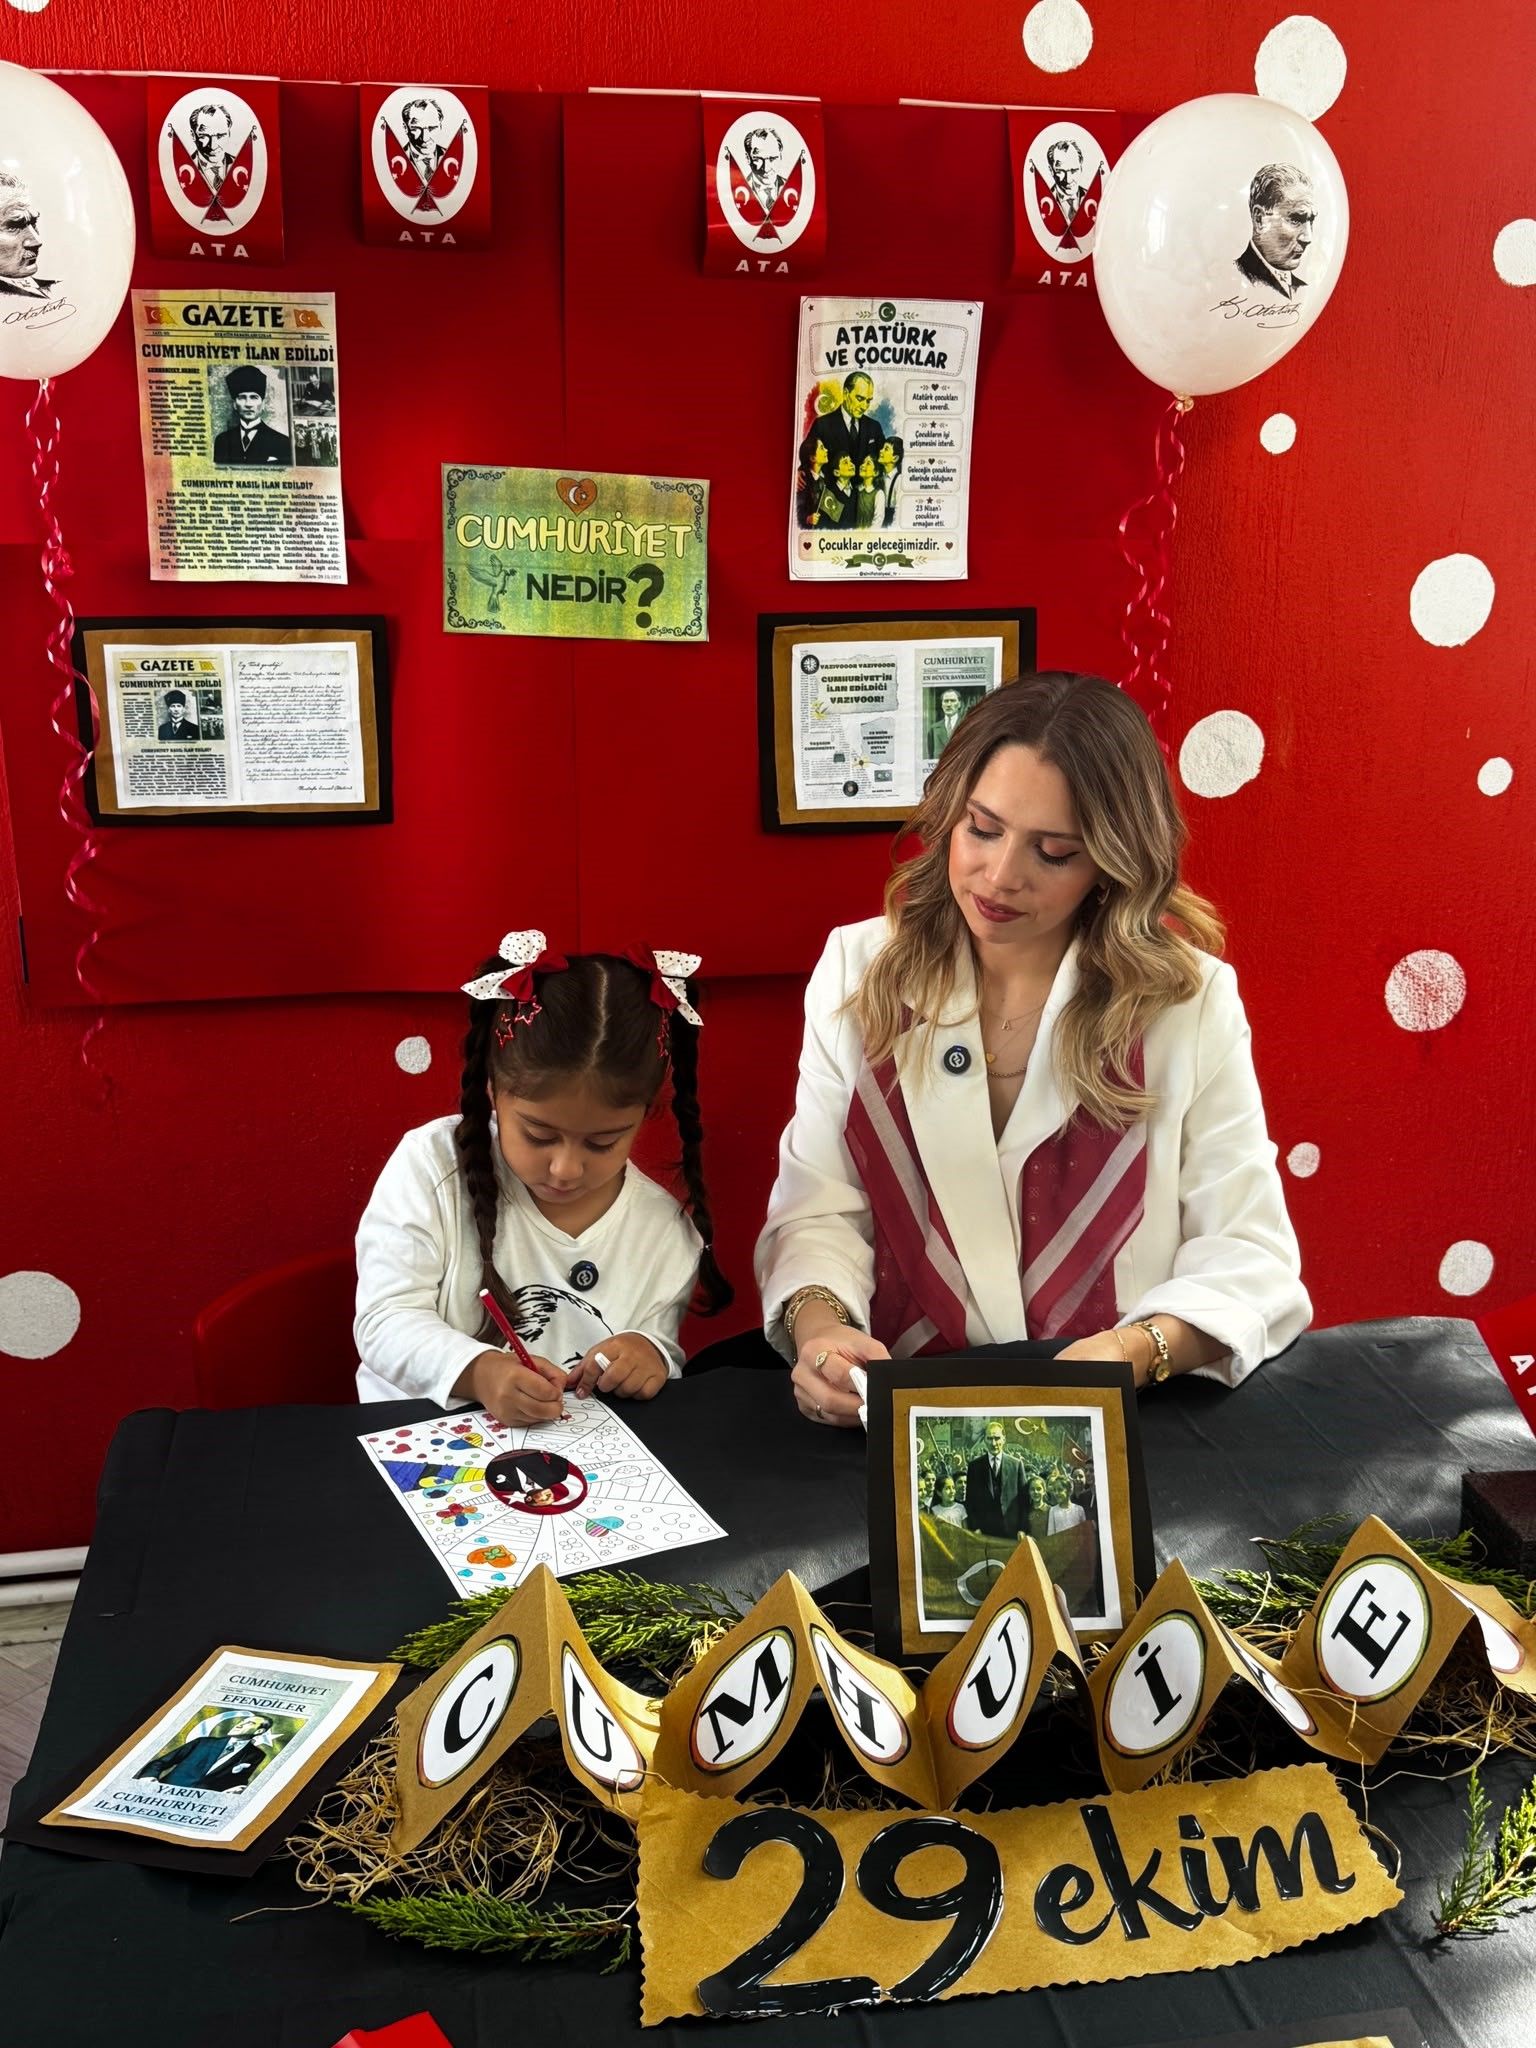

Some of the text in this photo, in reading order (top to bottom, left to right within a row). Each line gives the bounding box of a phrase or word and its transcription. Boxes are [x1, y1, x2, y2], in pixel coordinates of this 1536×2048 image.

[400, 230, 456, 245] ATA
[189, 242, 249, 258] ATA
[735, 259, 790, 274] ATA
[1038, 270, 1088, 287] ATA
[182, 304, 285, 327] GAZETE
[836, 322, 937, 348] ATATÜRK
[142, 342, 334, 362] CUMHURİYET İLAN EDİLDİ
[825, 347, 948, 370] VE ÇOCUKLAR
[912, 393, 933, 401] Atatürk
[919, 402, 929, 412] çok
[181, 479, 313, 490] CUMHURİYET NASIL İLAN EDİLDİ?
[455, 511, 692, 559] CUMHURİYET
[818, 538, 940, 553] Çocuklar geleceğimizdir.
[526, 562, 665, 629] NEDİR?
[141, 660, 195, 671] GAZETE
[924, 656, 985, 665] CUMHURİYET
[119, 678, 222, 689] CUMHURİYET İLAN EDİLDİ
[229, 1675, 331, 1696] CUMHURİYET
[221, 1694, 307, 1713] EFENDİLER
[157, 1785, 207, 1799] YARIN
[112, 1791, 228, 1816] CUMHURİYETİ
[94, 1800, 218, 1828] İLAN EDECEĞİZ.
[698, 1804, 1355, 2018] 29 ekim
